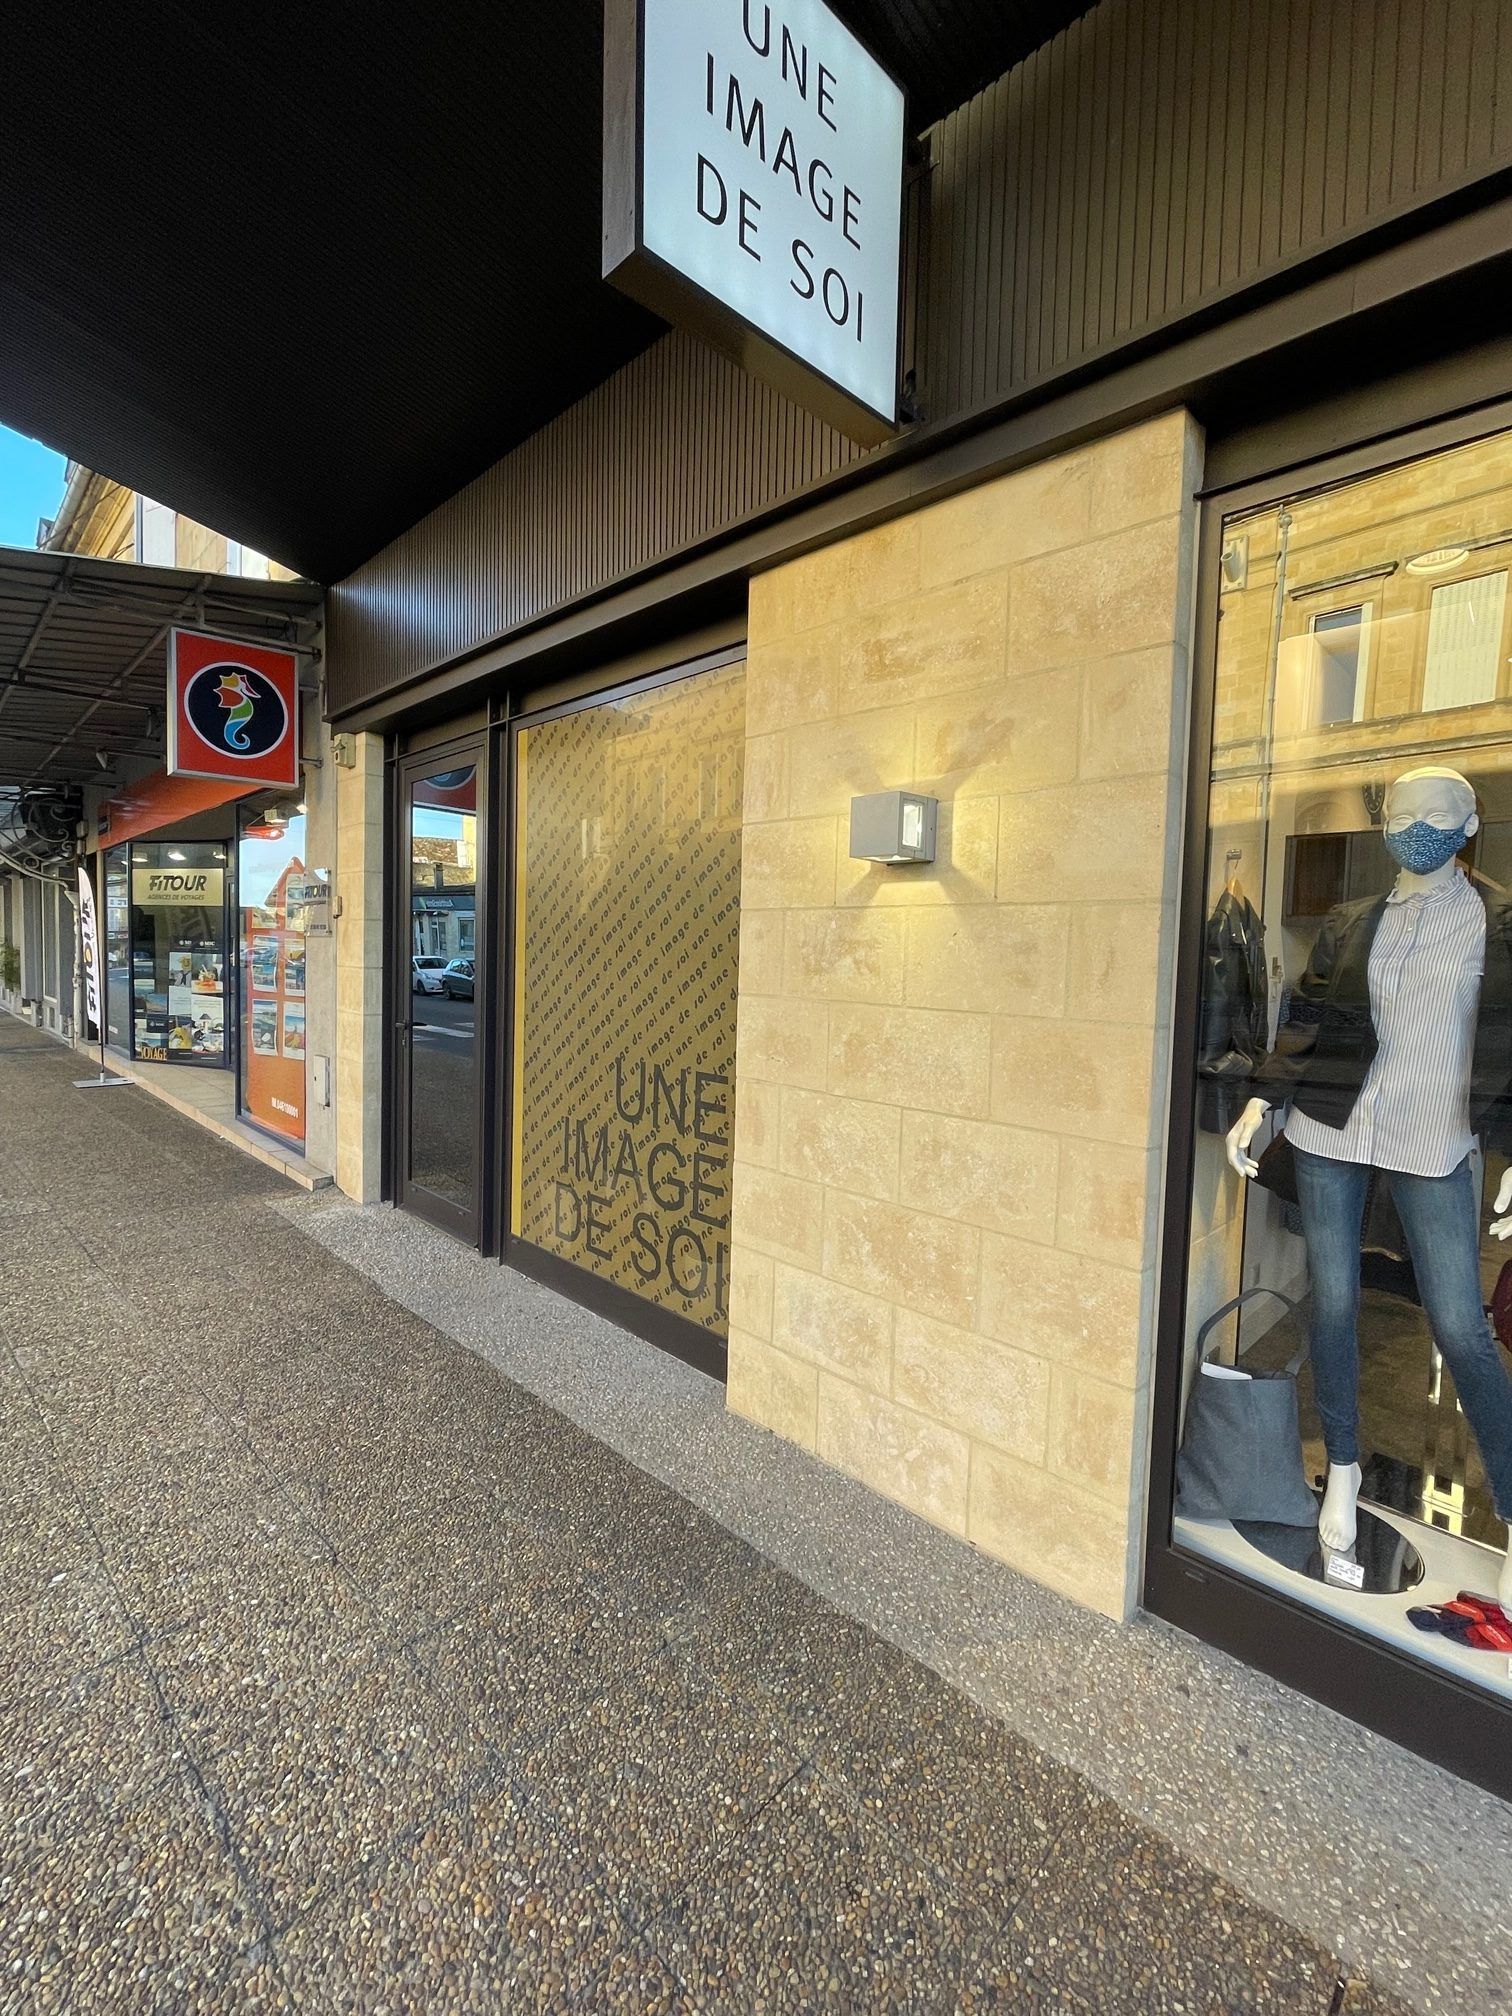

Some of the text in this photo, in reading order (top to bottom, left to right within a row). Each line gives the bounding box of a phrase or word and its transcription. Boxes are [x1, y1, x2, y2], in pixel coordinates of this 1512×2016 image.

[742, 0, 837, 132] UNE
[706, 51, 861, 250] IMAGE
[697, 152, 863, 343] DE SOI
[536, 750, 557, 785] image
[536, 816, 547, 836] une
[596, 716, 610, 739] une
[546, 724, 558, 745] une
[558, 754, 570, 775] une
[571, 715, 594, 752] image
[527, 841, 547, 873] image
[571, 785, 584, 806] une
[548, 847, 560, 867] une
[527, 904, 538, 922] une
[539, 872, 560, 904] image
[527, 1024, 539, 1041] une
[540, 996, 561, 1024] image
[586, 946, 600, 965] une
[601, 912, 626, 945] image
[630, 895, 640, 910] de
[657, 852, 673, 874] une
[528, 962, 549, 991] image
[573, 912, 586, 932] une
[587, 878, 611, 911] image
[641, 816, 656, 838] une
[538, 936, 550, 954] une
[551, 904, 573, 935] image
[550, 968, 563, 986] une
[564, 938, 586, 968] image
[612, 884, 627, 905] une
[628, 847, 655, 883] image
[560, 879, 573, 898] une
[563, 1002, 576, 1020] une
[577, 972, 600, 1002] image
[628, 919, 642, 940] une
[643, 883, 671, 919] image
[675, 865, 686, 881] de
[532, 1080, 552, 1106] image
[576, 1037, 589, 1055] une
[590, 1008, 614, 1038] image
[642, 957, 658, 977] une
[660, 921, 689, 956] image
[692, 903, 704, 919] de
[539, 1058, 550, 1074] une
[552, 1030, 574, 1058] image
[600, 981, 614, 1000] une
[616, 948, 642, 980] image
[645, 932, 655, 947] de
[674, 889, 691, 911] une
[693, 848, 724, 887] image
[551, 1092, 563, 1108] une
[564, 1066, 587, 1092] image
[614, 1018, 628, 1037] une
[630, 986, 657, 1018] image
[661, 969, 672, 984] de
[691, 928, 709, 950] une
[531, 1139, 543, 1154] une
[544, 1115, 565, 1140] image
[589, 1074, 603, 1091] une
[632, 1031, 642, 1045] de
[659, 995, 675, 1015] une
[676, 960, 706, 995] image
[710, 942, 722, 959] de
[646, 1025, 674, 1056] image
[678, 1009, 689, 1024] de
[675, 1035, 692, 1055] une
[694, 1001, 725, 1035] image
[696, 1050, 707, 1065] de
[616, 1057, 728, 1146] UNE
[562, 1116, 727, 1229] IMAGE
[555, 1180, 723, 1311] DE SOI
